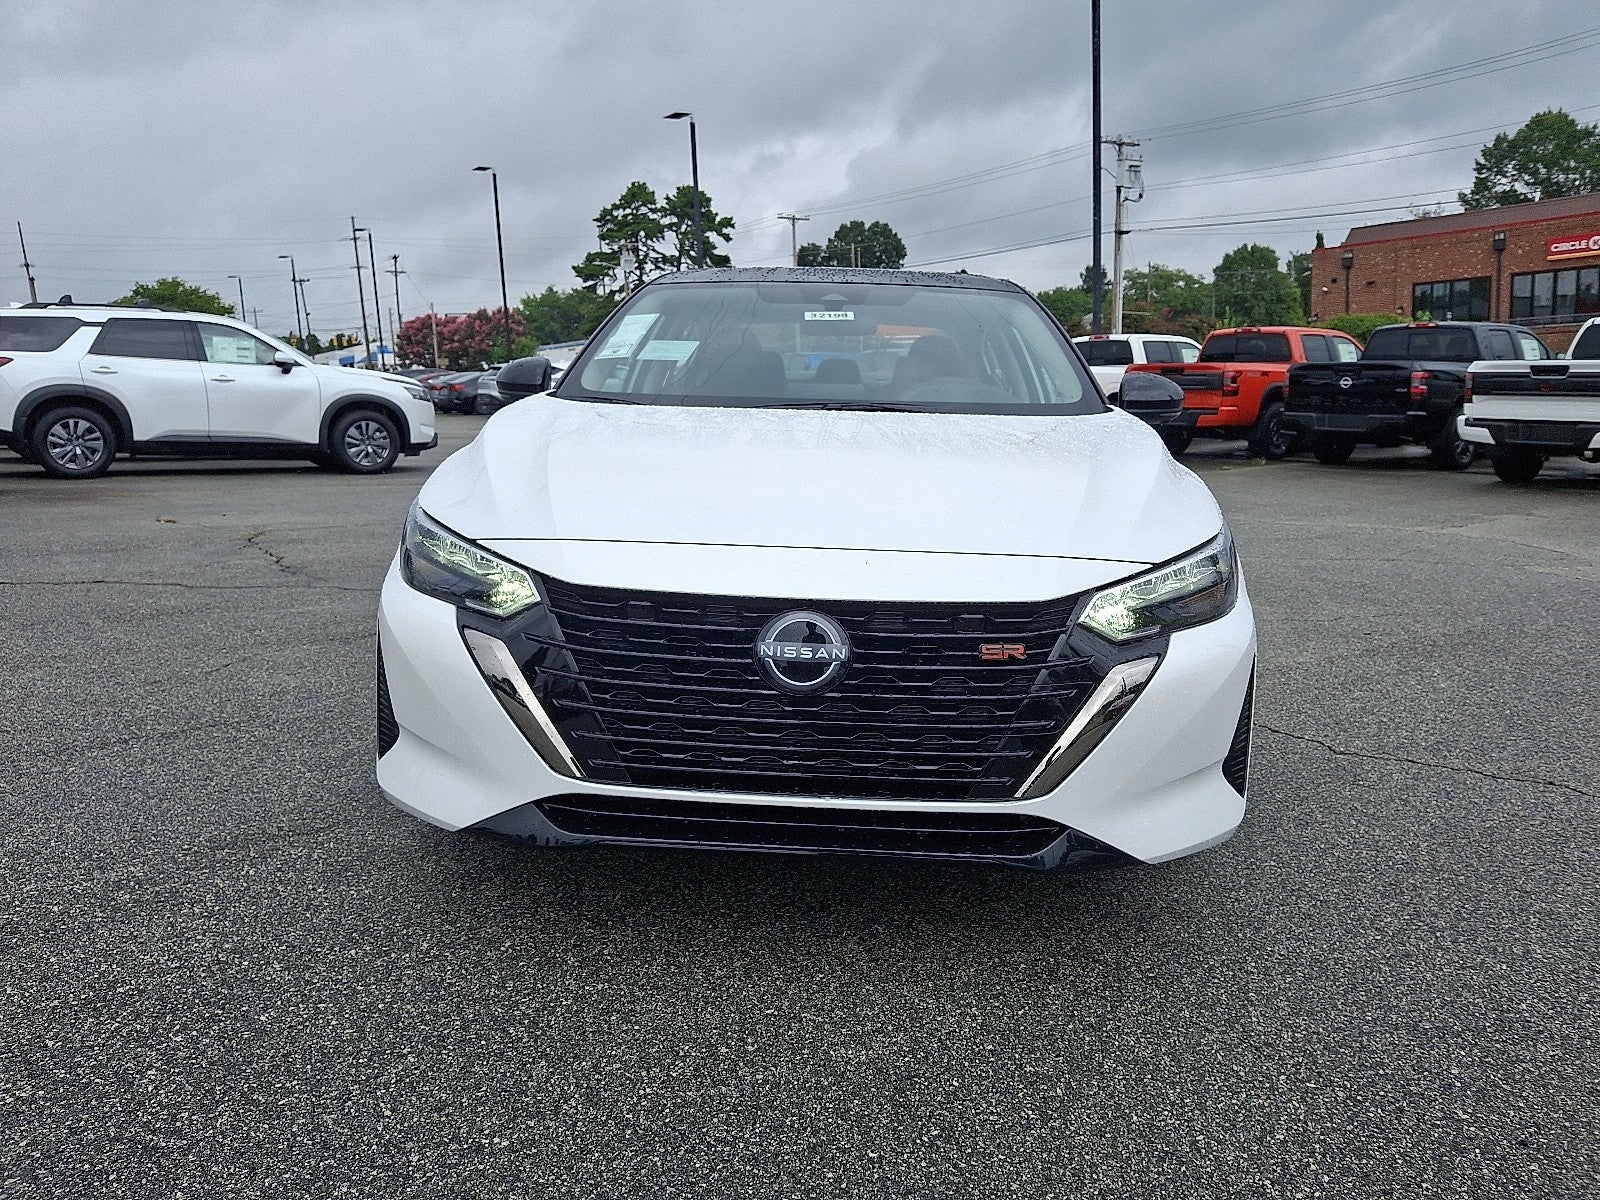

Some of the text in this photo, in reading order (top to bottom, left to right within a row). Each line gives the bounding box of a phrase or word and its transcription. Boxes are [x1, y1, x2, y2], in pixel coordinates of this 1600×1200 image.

[1551, 240, 1588, 252] CIRCLE
[760, 644, 846, 659] NISSAN
[979, 643, 1026, 660] SR
